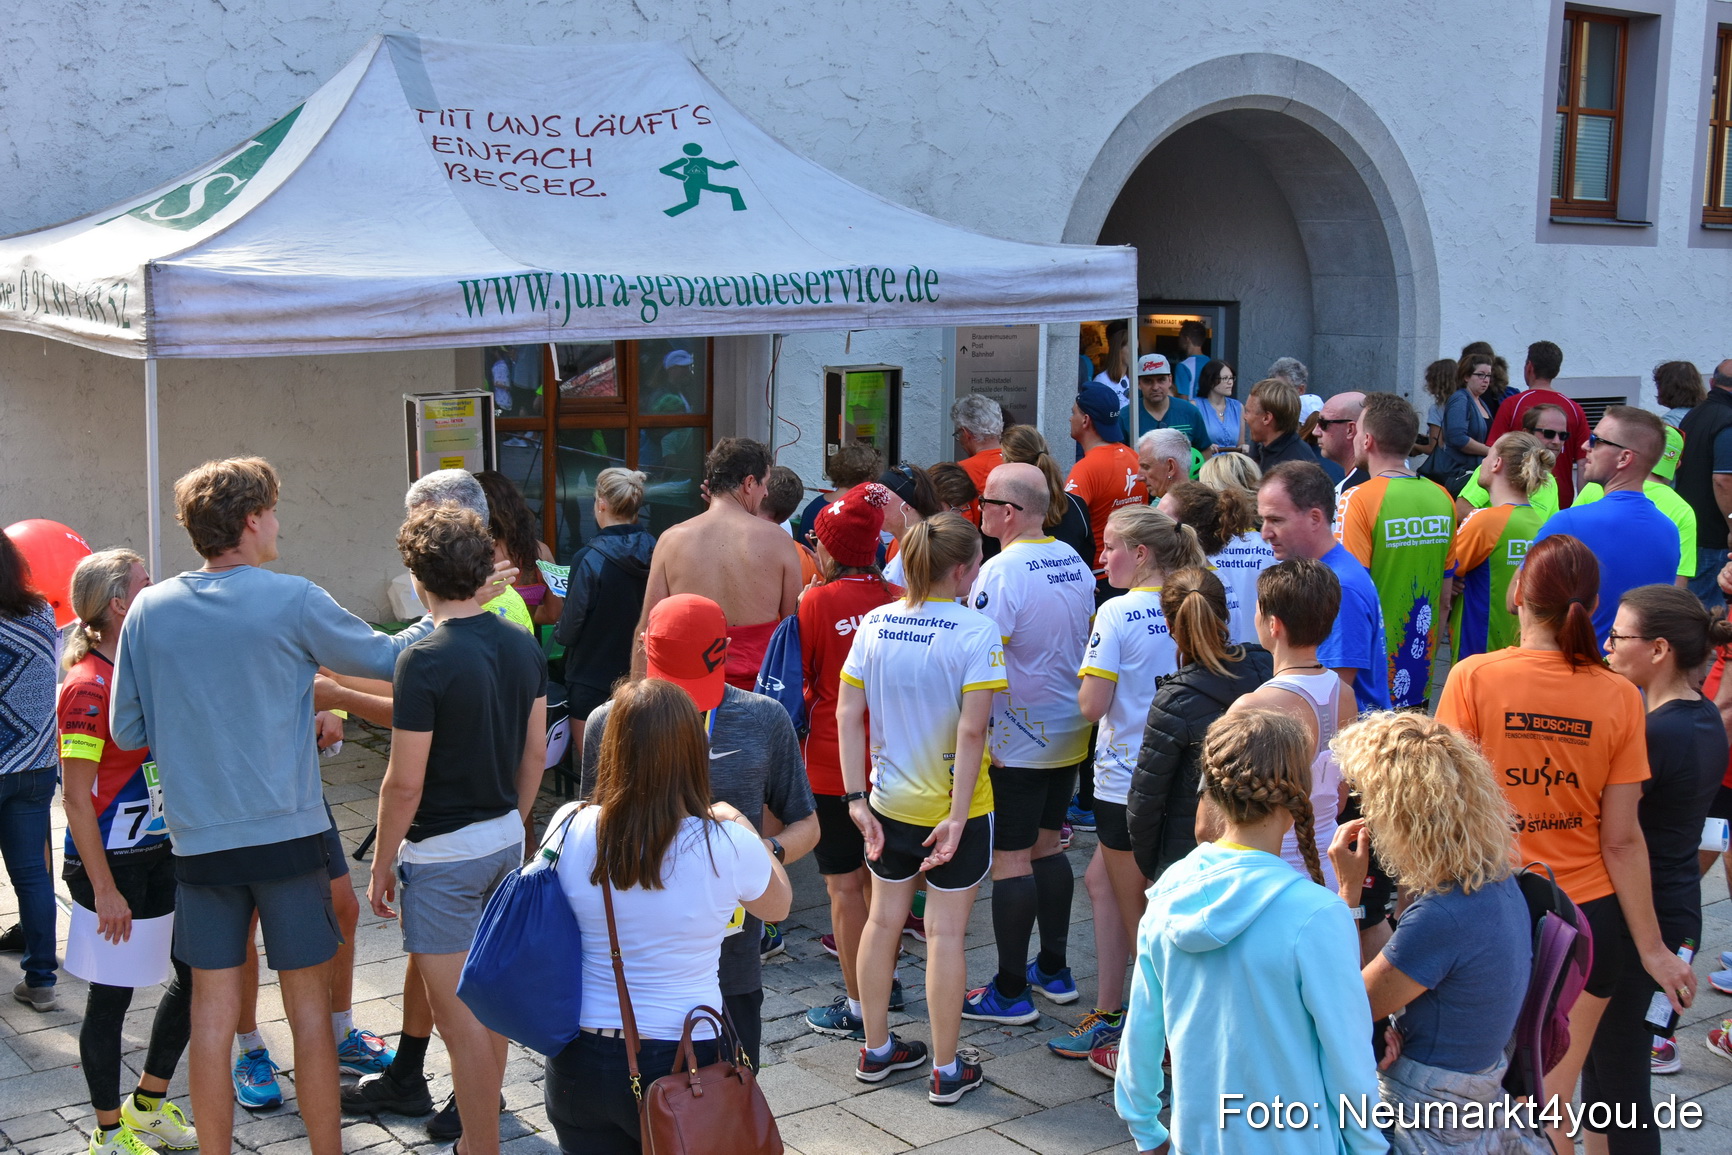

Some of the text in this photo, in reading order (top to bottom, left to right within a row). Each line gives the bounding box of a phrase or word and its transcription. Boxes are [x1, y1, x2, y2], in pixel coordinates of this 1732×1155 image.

[487, 111, 562, 138] UNS
[444, 162, 608, 197] BESSER.
[458, 265, 940, 327] www.jura-gebaeudeservice.de
[971, 333, 1018, 341] Brauereimuseum
[971, 342, 984, 350] Post
[1385, 516, 1451, 541] BOCK
[1385, 539, 1411, 549] inspired
[1026, 559, 1044, 572] 20.
[1215, 559, 1262, 570] Stadtlauf
[1047, 569, 1083, 585] Stadtlauf
[869, 613, 959, 631] 20. Neumarkter
[1125, 610, 1146, 623] 20.
[878, 628, 936, 646] Stadtlauf
[66, 720, 97, 733] BMW M.
[1015, 721, 1038, 744] September
[1532, 716, 1589, 735] BÜSCHEL
